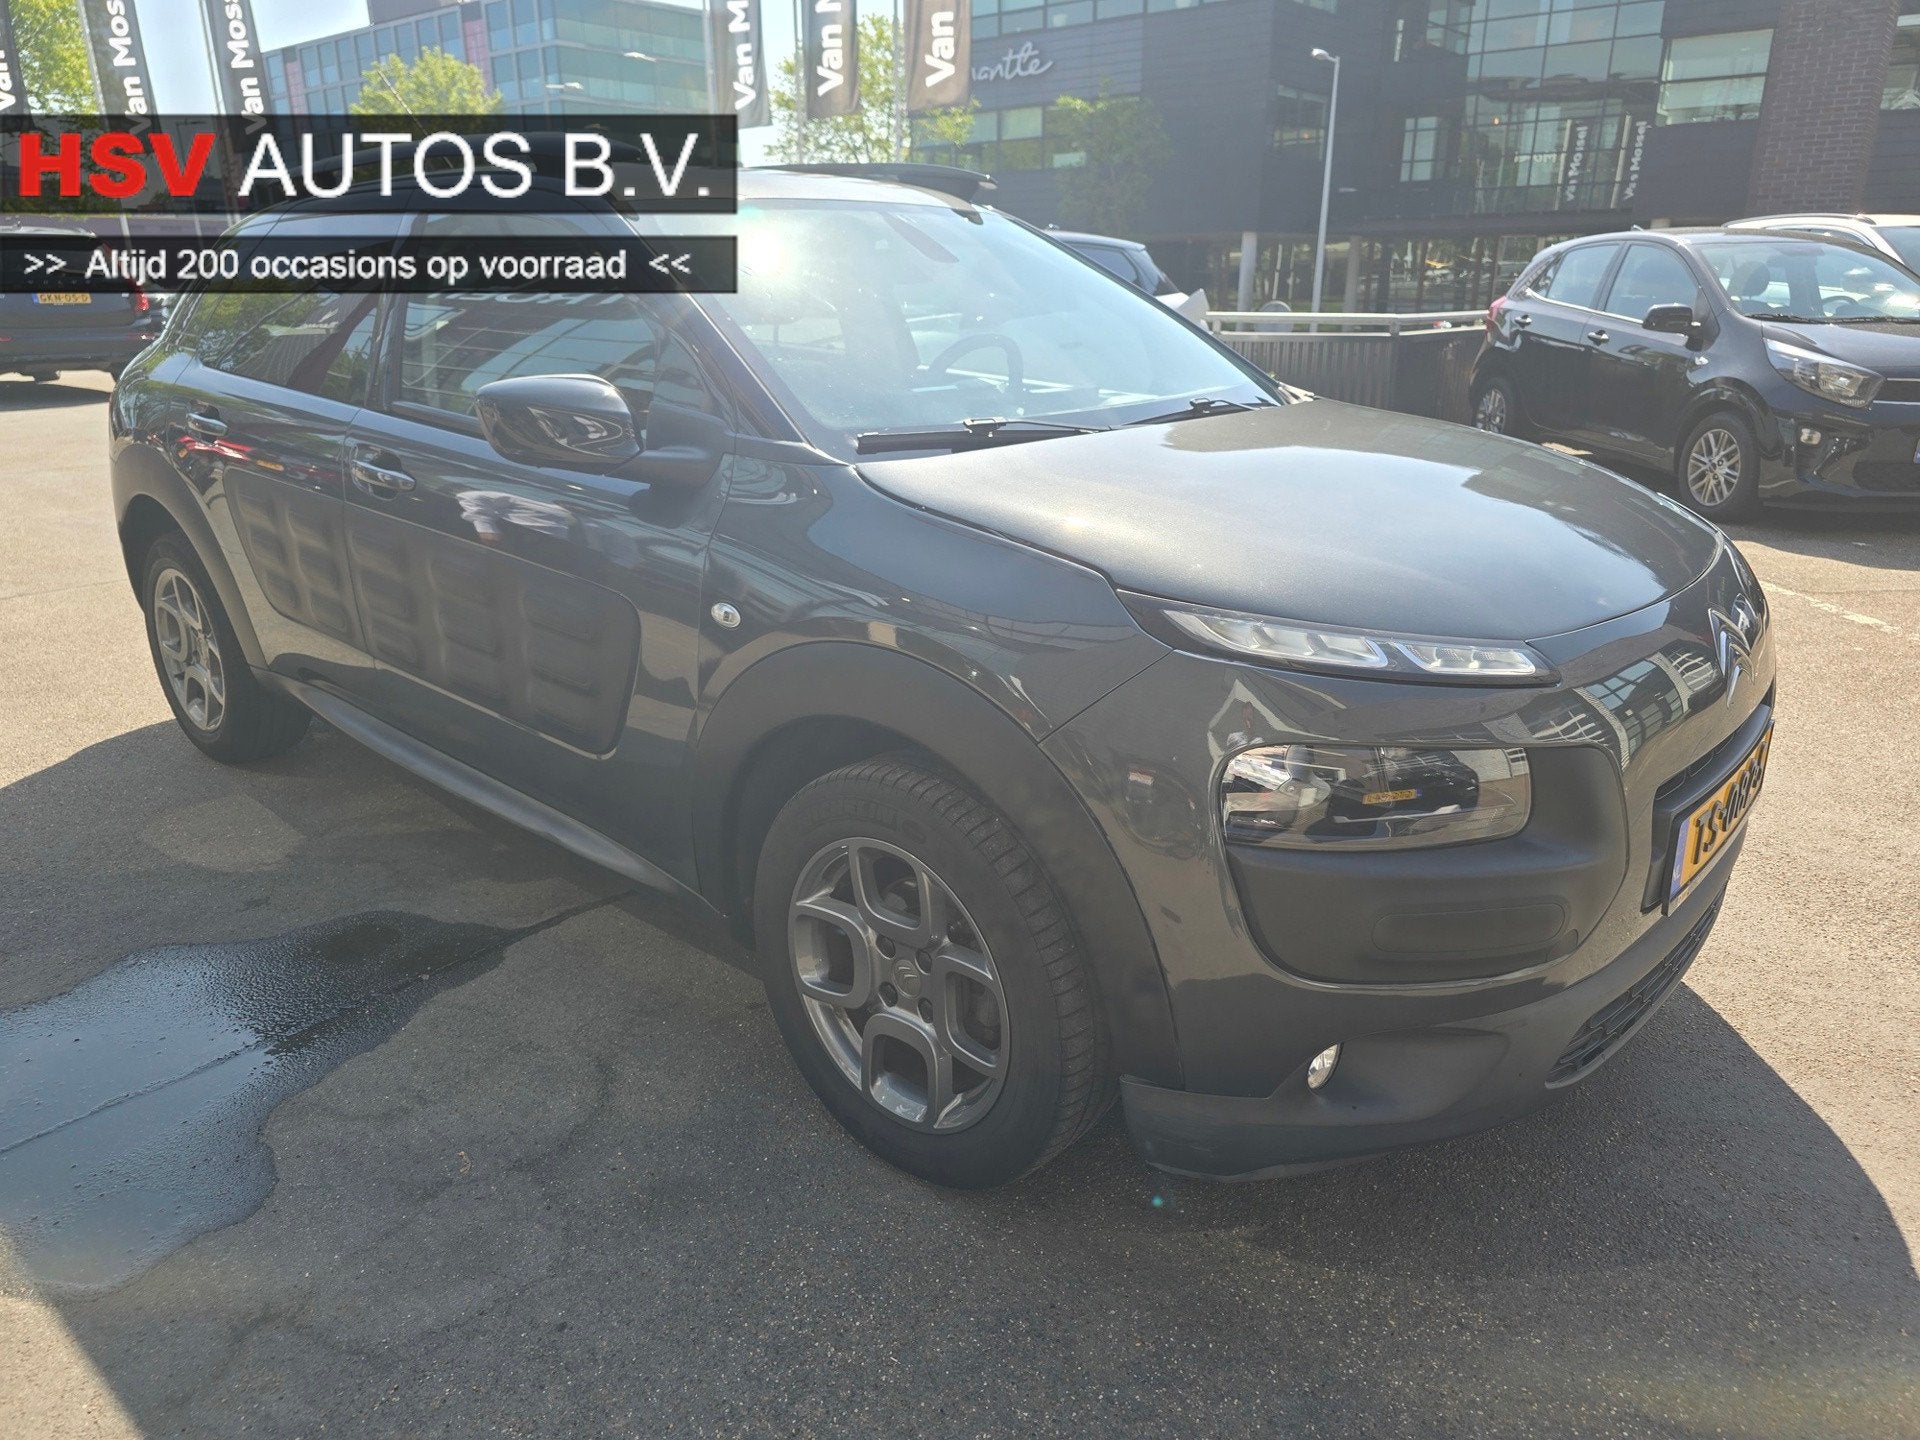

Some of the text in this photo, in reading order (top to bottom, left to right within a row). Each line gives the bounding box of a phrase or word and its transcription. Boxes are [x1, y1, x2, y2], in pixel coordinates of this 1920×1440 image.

[732, 42, 757, 111] Van
[815, 24, 845, 97] Van
[924, 10, 957, 88] Van
[239, 76, 267, 135] Van
